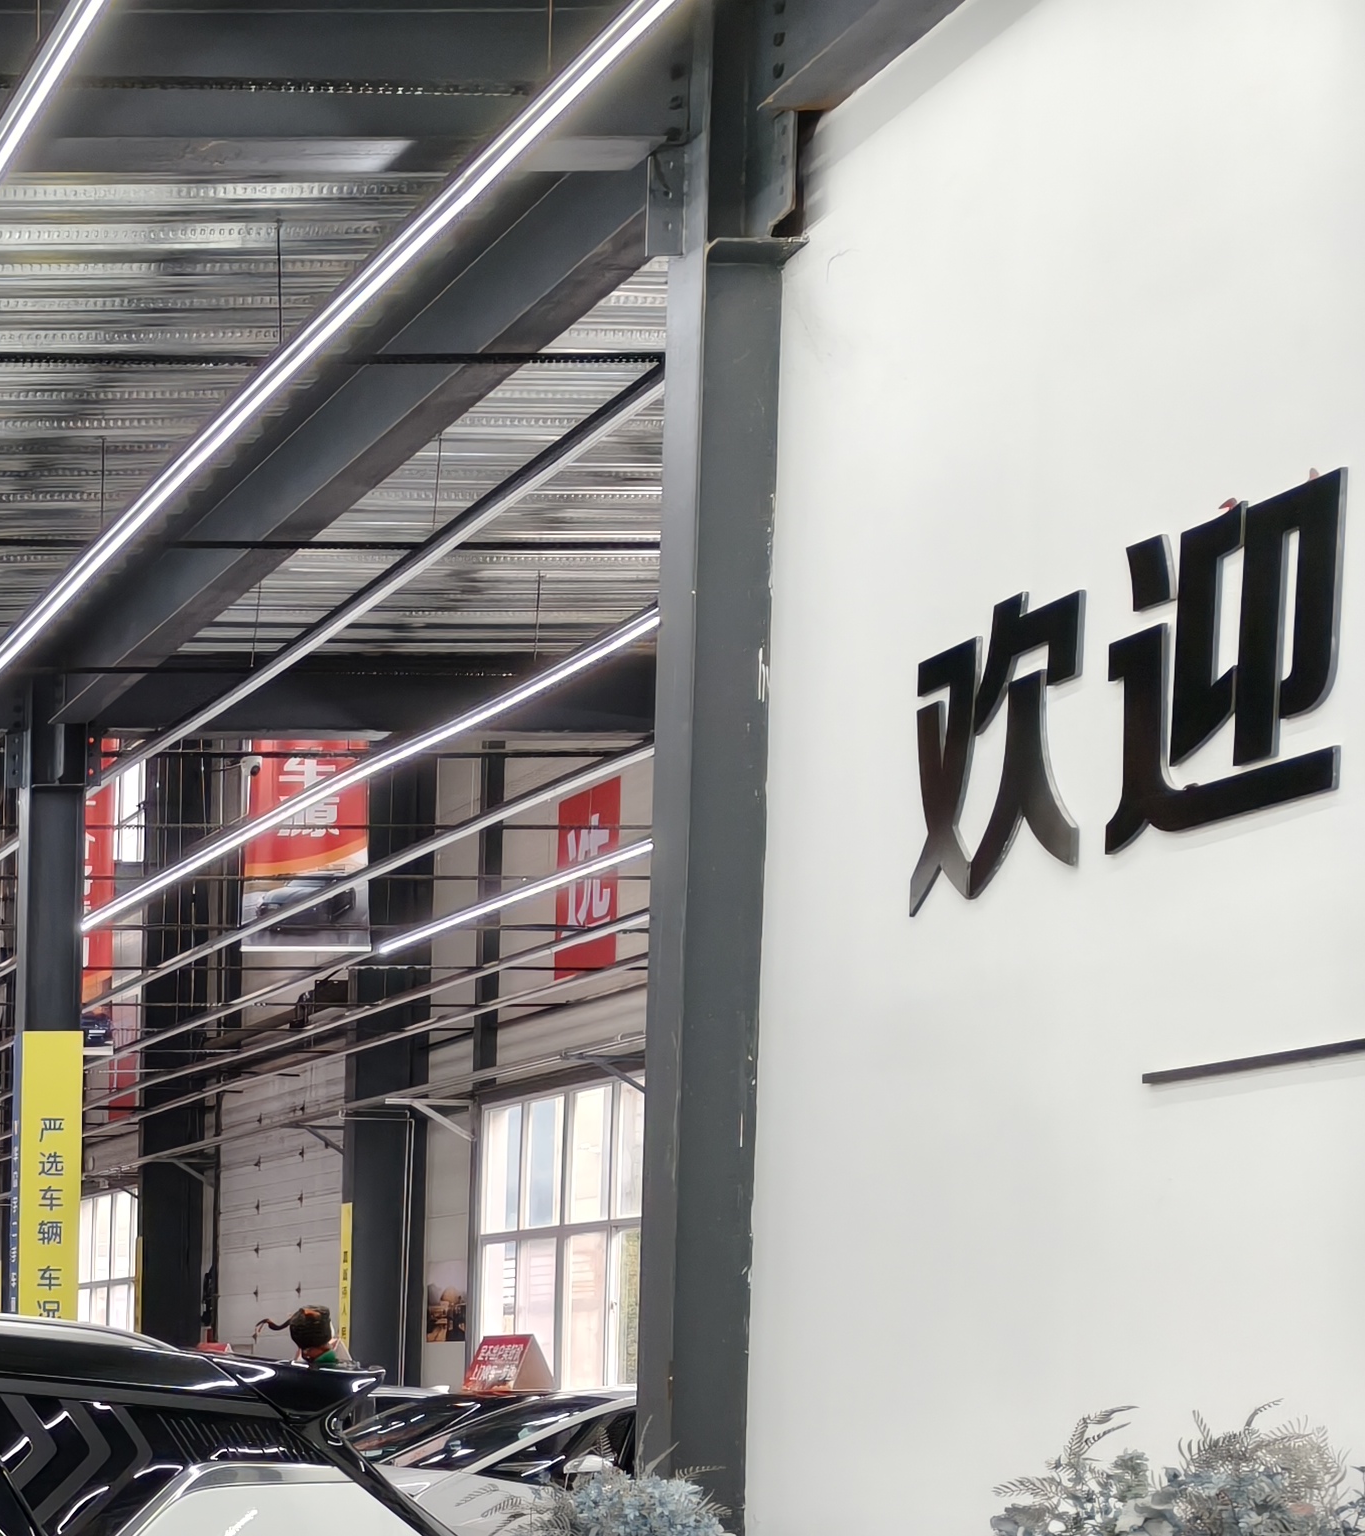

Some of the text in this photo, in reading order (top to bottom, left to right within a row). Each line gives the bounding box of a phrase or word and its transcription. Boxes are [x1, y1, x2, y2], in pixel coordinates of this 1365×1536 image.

[910, 467, 1348, 917] 欢迎
[36, 1118, 65, 1319] 严选车辆 车况
